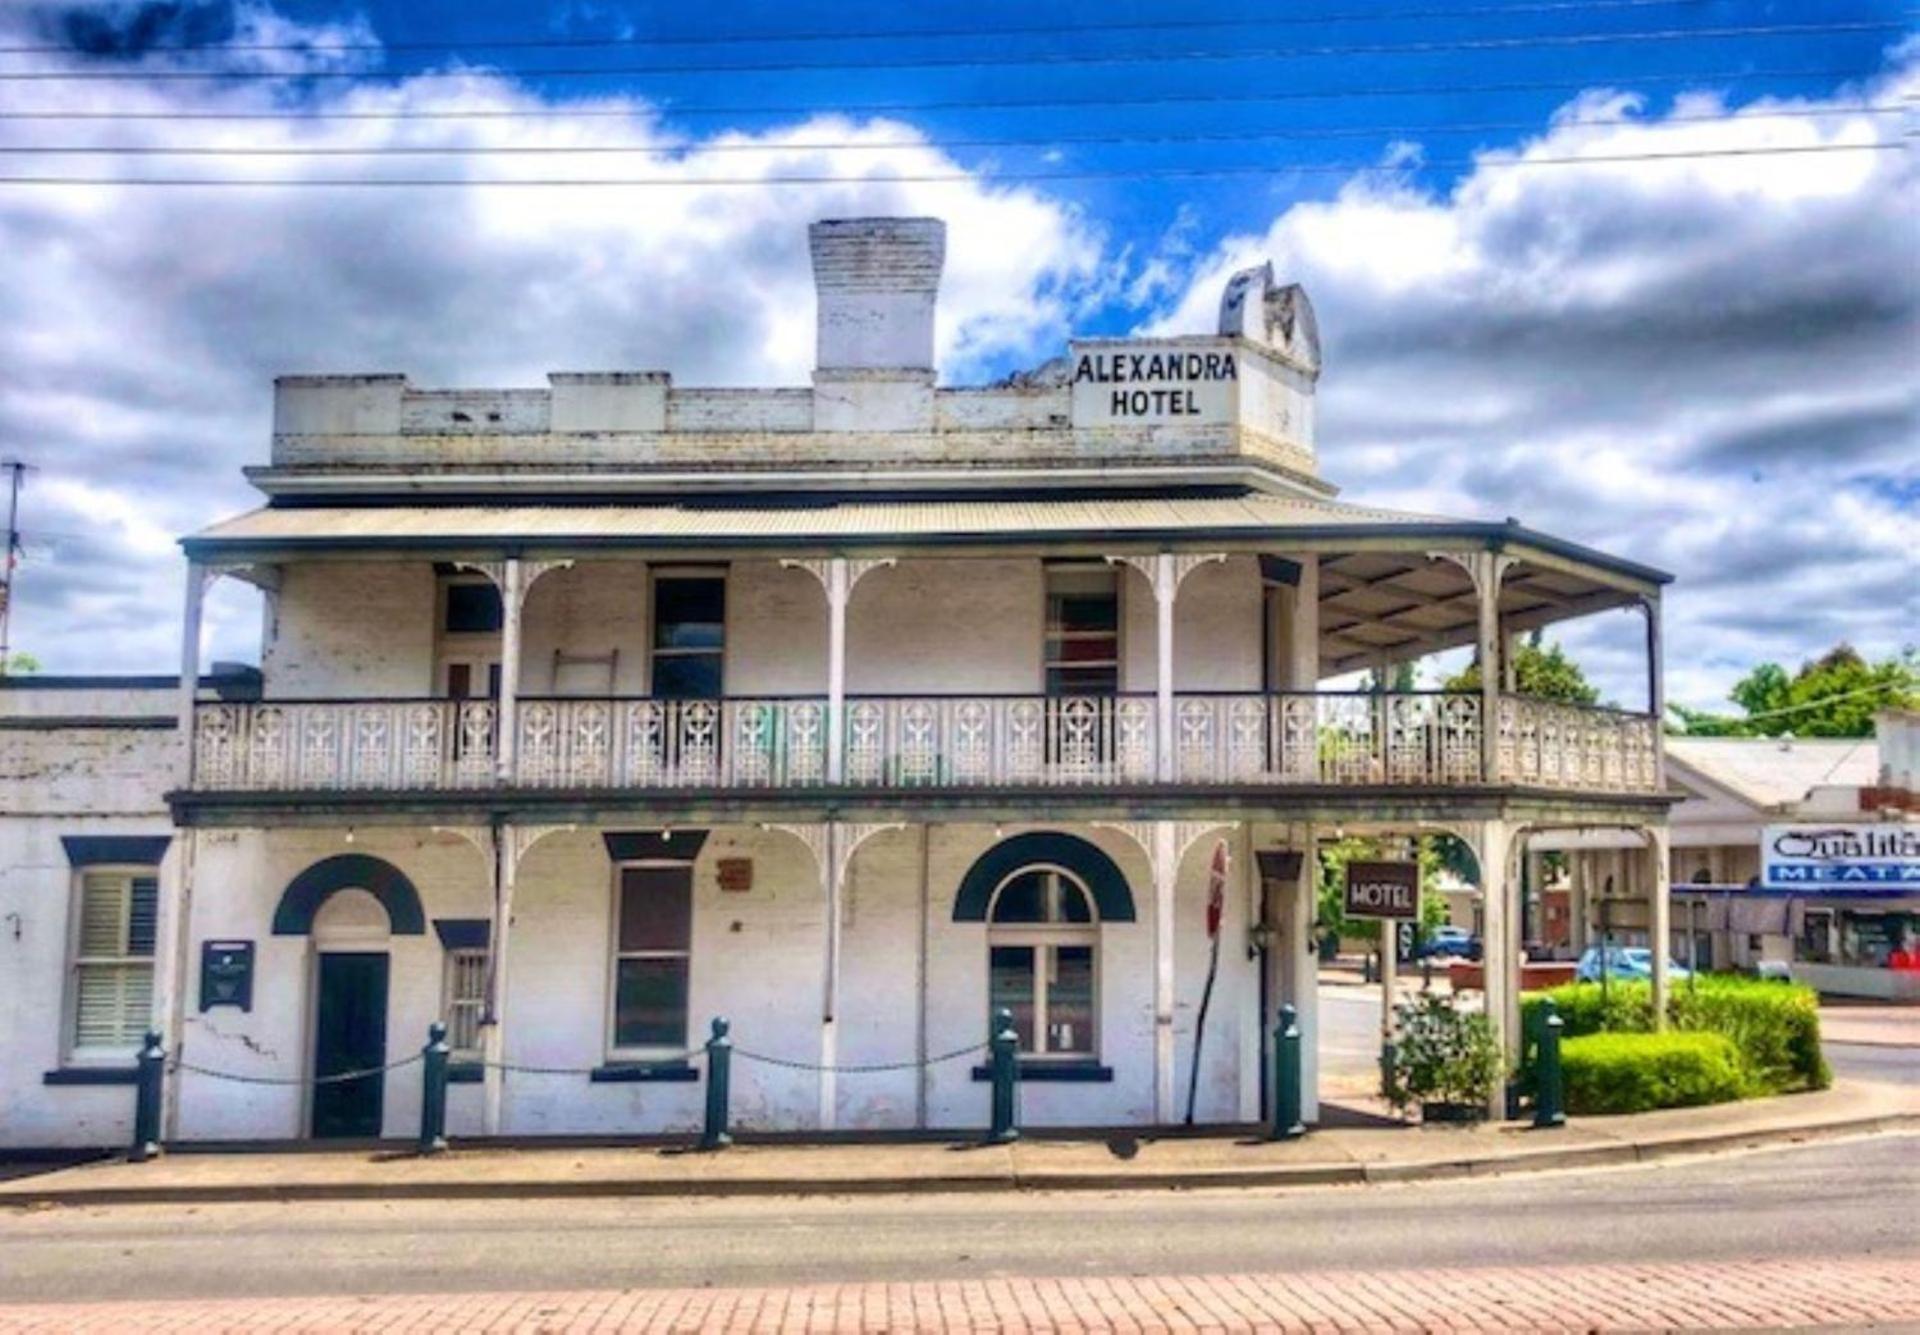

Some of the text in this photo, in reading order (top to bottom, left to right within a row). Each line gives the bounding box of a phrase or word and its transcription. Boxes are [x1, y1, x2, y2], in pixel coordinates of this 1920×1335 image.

[1074, 353, 1238, 383] ALEXANDRA
[1111, 390, 1202, 416] HOTEL
[1351, 883, 1411, 908] HOTEL
